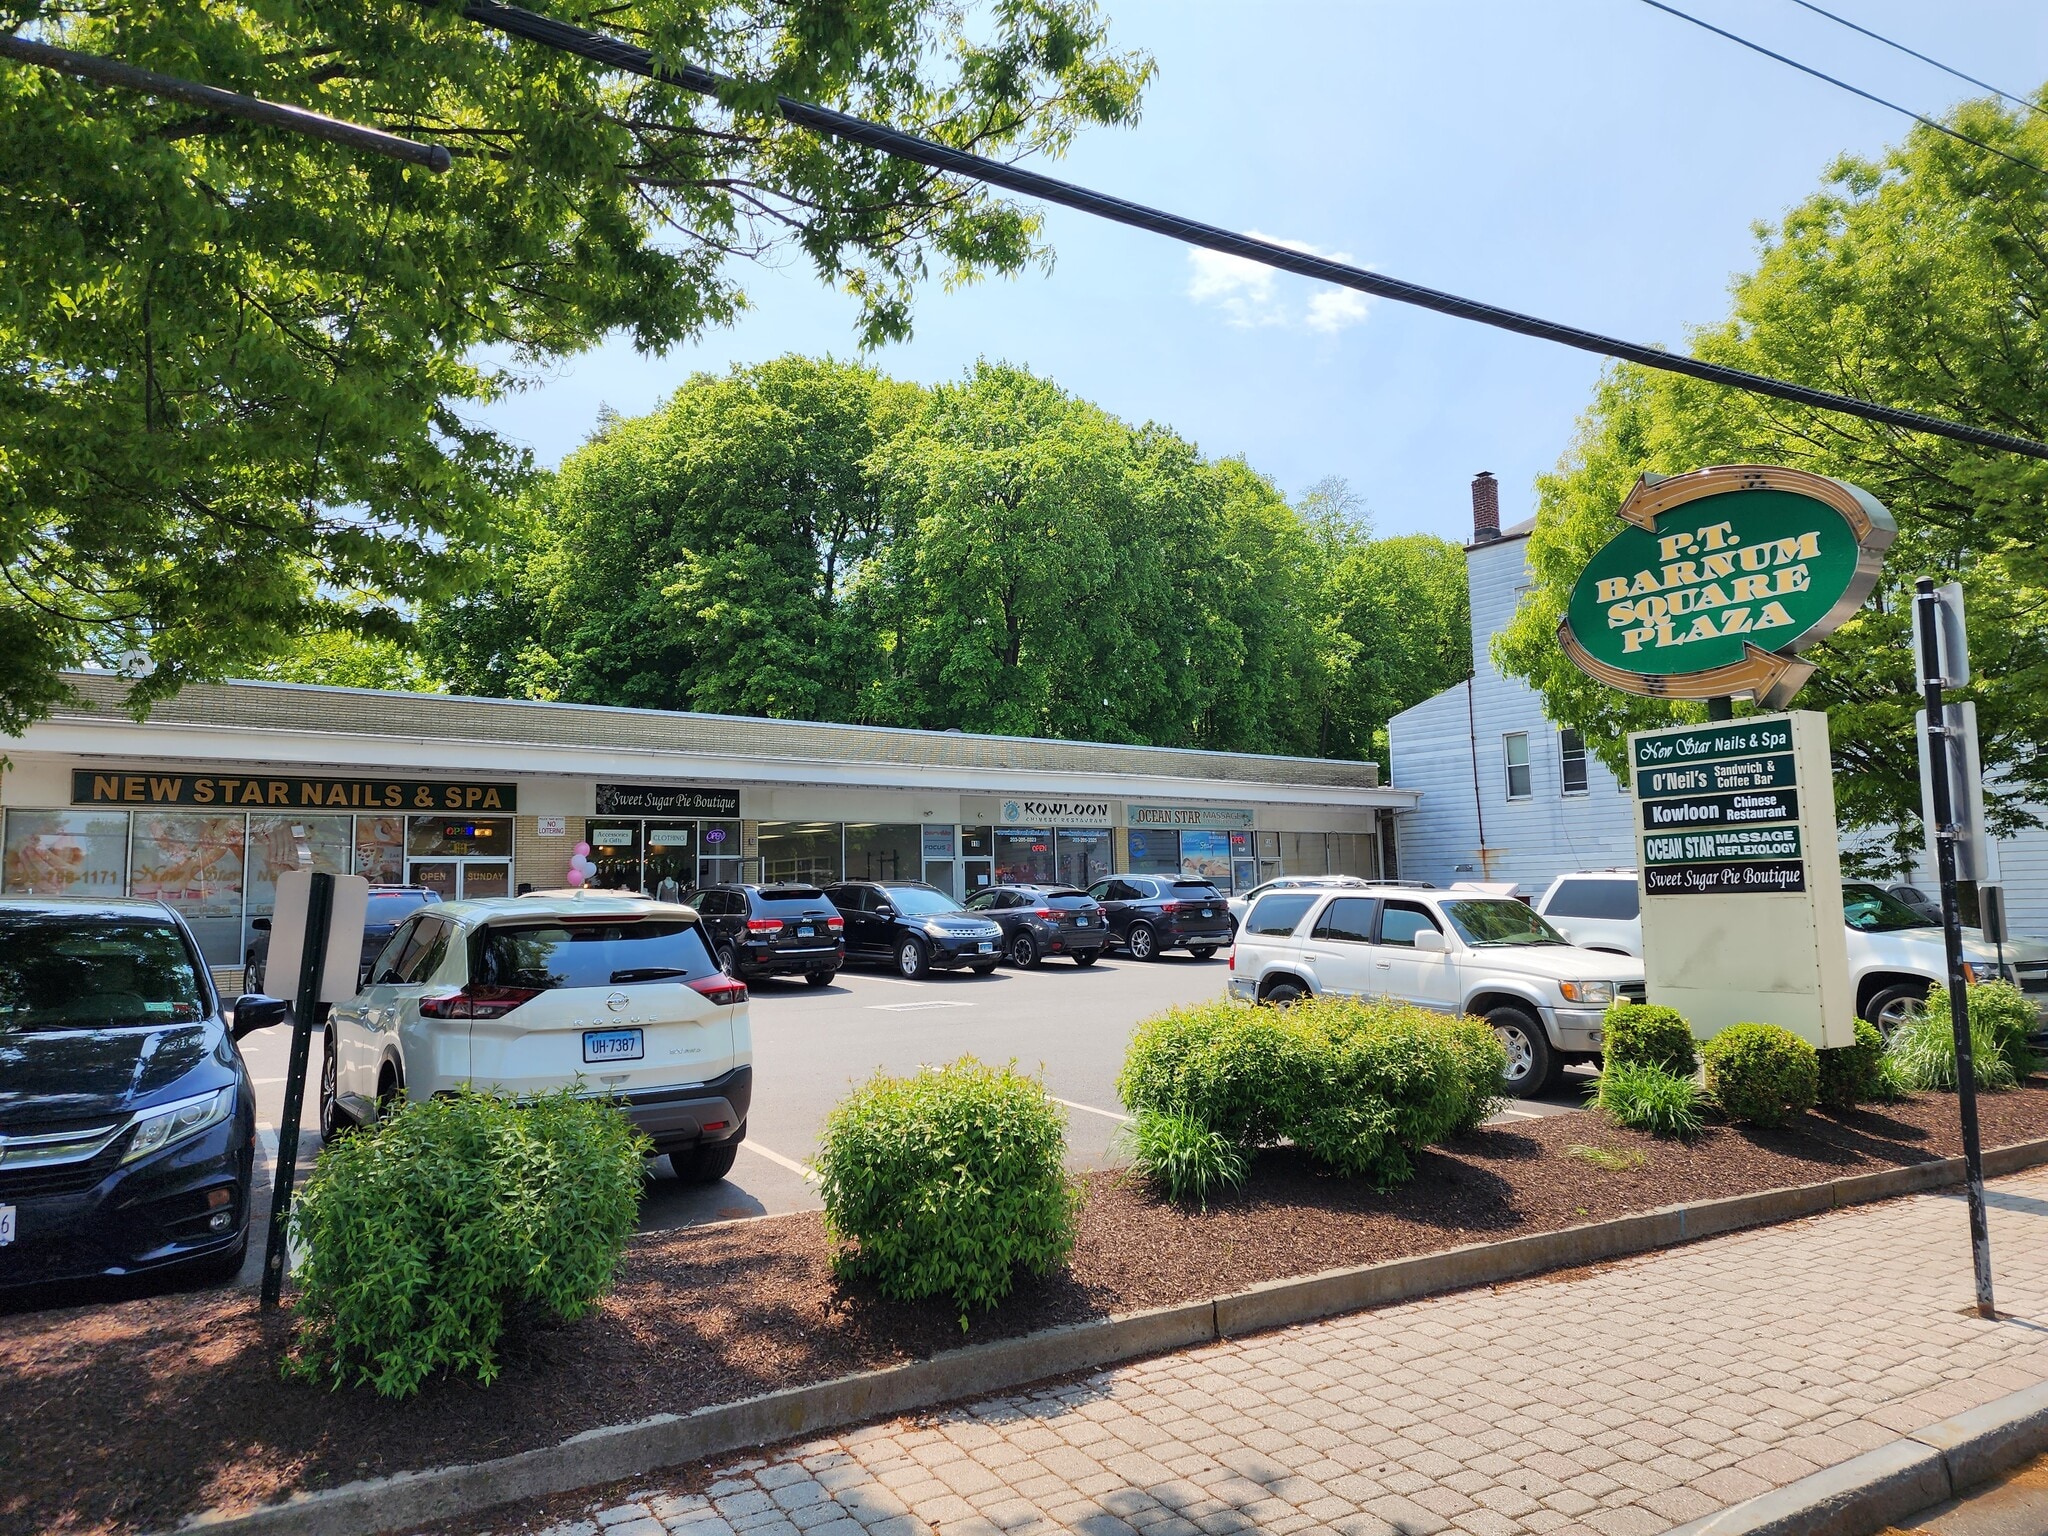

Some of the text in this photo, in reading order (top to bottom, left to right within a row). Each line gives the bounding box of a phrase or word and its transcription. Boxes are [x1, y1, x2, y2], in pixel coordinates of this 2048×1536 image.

[1659, 521, 1741, 562] P.T.
[1596, 531, 1821, 603] BARNUM
[1607, 563, 1811, 629] SQUARE
[1622, 602, 1795, 654] PLAZA
[1640, 732, 1787, 760] New Star Nails & Spa
[1714, 760, 1776, 777] Sandwich &
[1653, 771, 1707, 791] O'Neil's
[1717, 774, 1773, 788] Coffee Bar
[93, 776, 502, 809] NEW STAR NAILS & SPA
[611, 791, 736, 812] Sweet Sugar Pie Boutique
[1024, 801, 1108, 816] KOWLOON
[1734, 795, 1777, 808] Chinese
[1138, 809, 1172, 823] OCEAN
[1175, 810, 1202, 824] STAR
[1202, 811, 1241, 820] MASSAGE
[1652, 804, 1719, 823] Kowloon
[1726, 806, 1787, 820] Restaurant
[598, 830, 629, 839] Accessories
[653, 834, 686, 842] CLOTHING
[707, 831, 725, 841] OPEN
[1715, 830, 1794, 844] MASSAGE
[1646, 836, 1716, 861] OCEAN STAR
[1717, 842, 1797, 856] REFLEXOLOGY
[420, 872, 504, 881] OPEN SUNDAY
[1648, 866, 1800, 891] Sweet Sugar Pie Boutique
[573, 1014, 658, 1027] ROGUE
